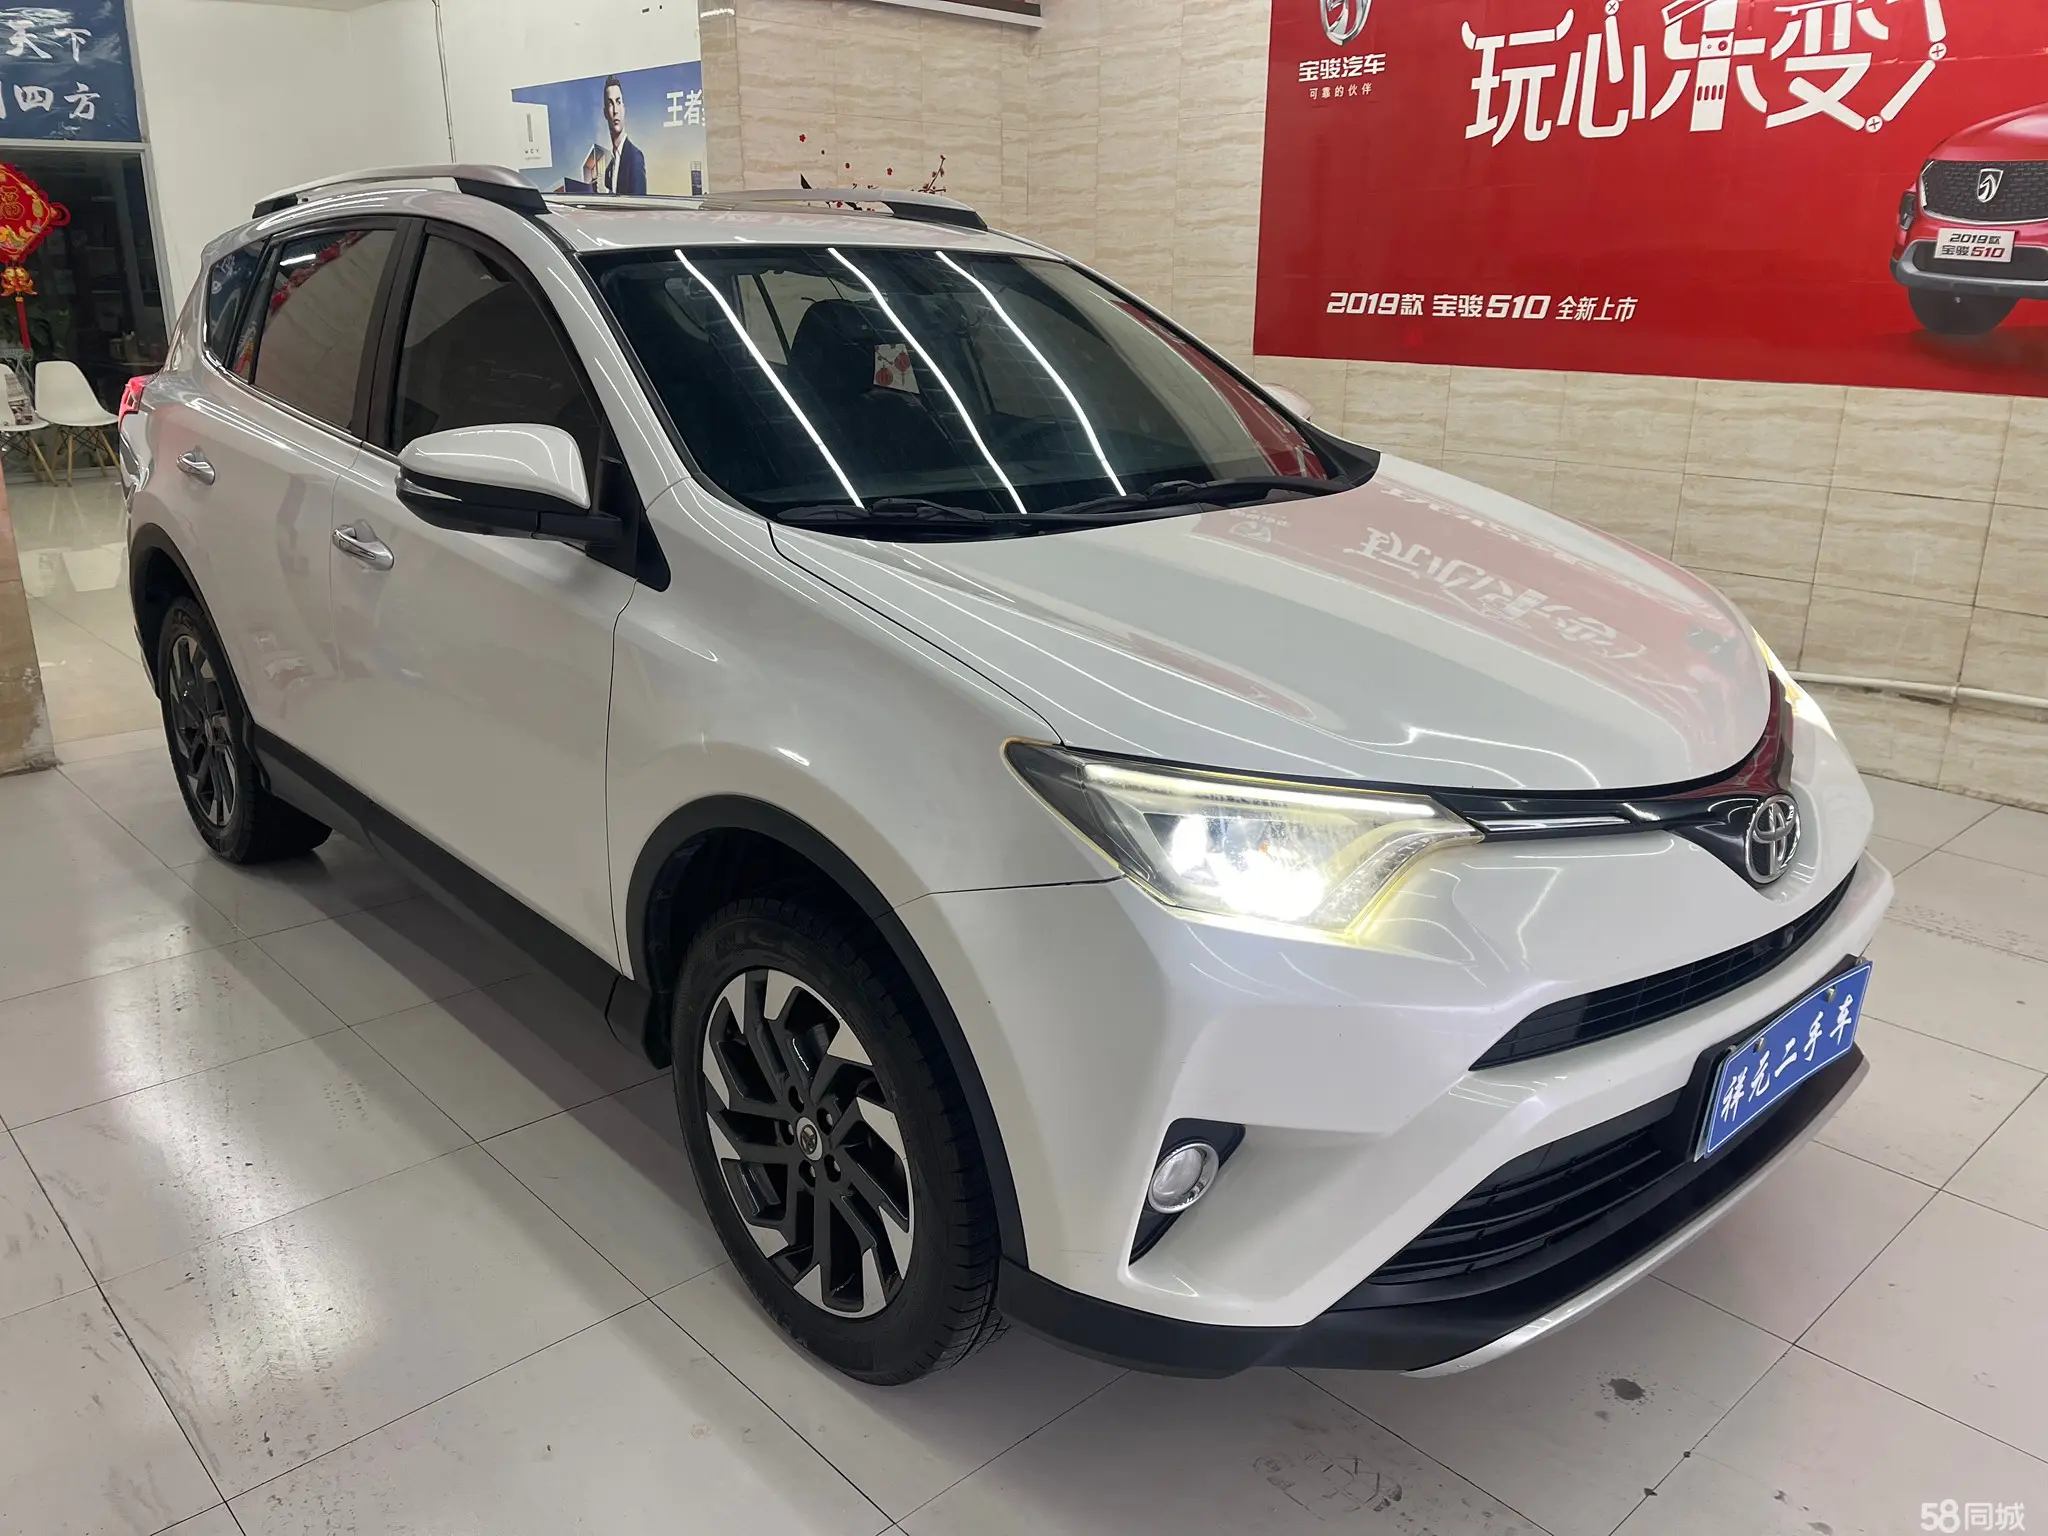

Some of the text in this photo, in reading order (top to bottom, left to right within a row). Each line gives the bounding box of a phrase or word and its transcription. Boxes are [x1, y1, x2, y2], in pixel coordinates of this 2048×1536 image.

[1298, 53, 1386, 82] 宝骏汽车
[0, 81, 101, 120] 四方
[1309, 83, 1372, 100] 可靠的伙伴
[663, 89, 706, 127] 王者
[1950, 233, 2001, 244] 2019款
[1326, 292, 1423, 316] 2019款
[1555, 295, 1638, 323] 全新上市
[1720, 994, 1854, 1122] 祥元二手车
